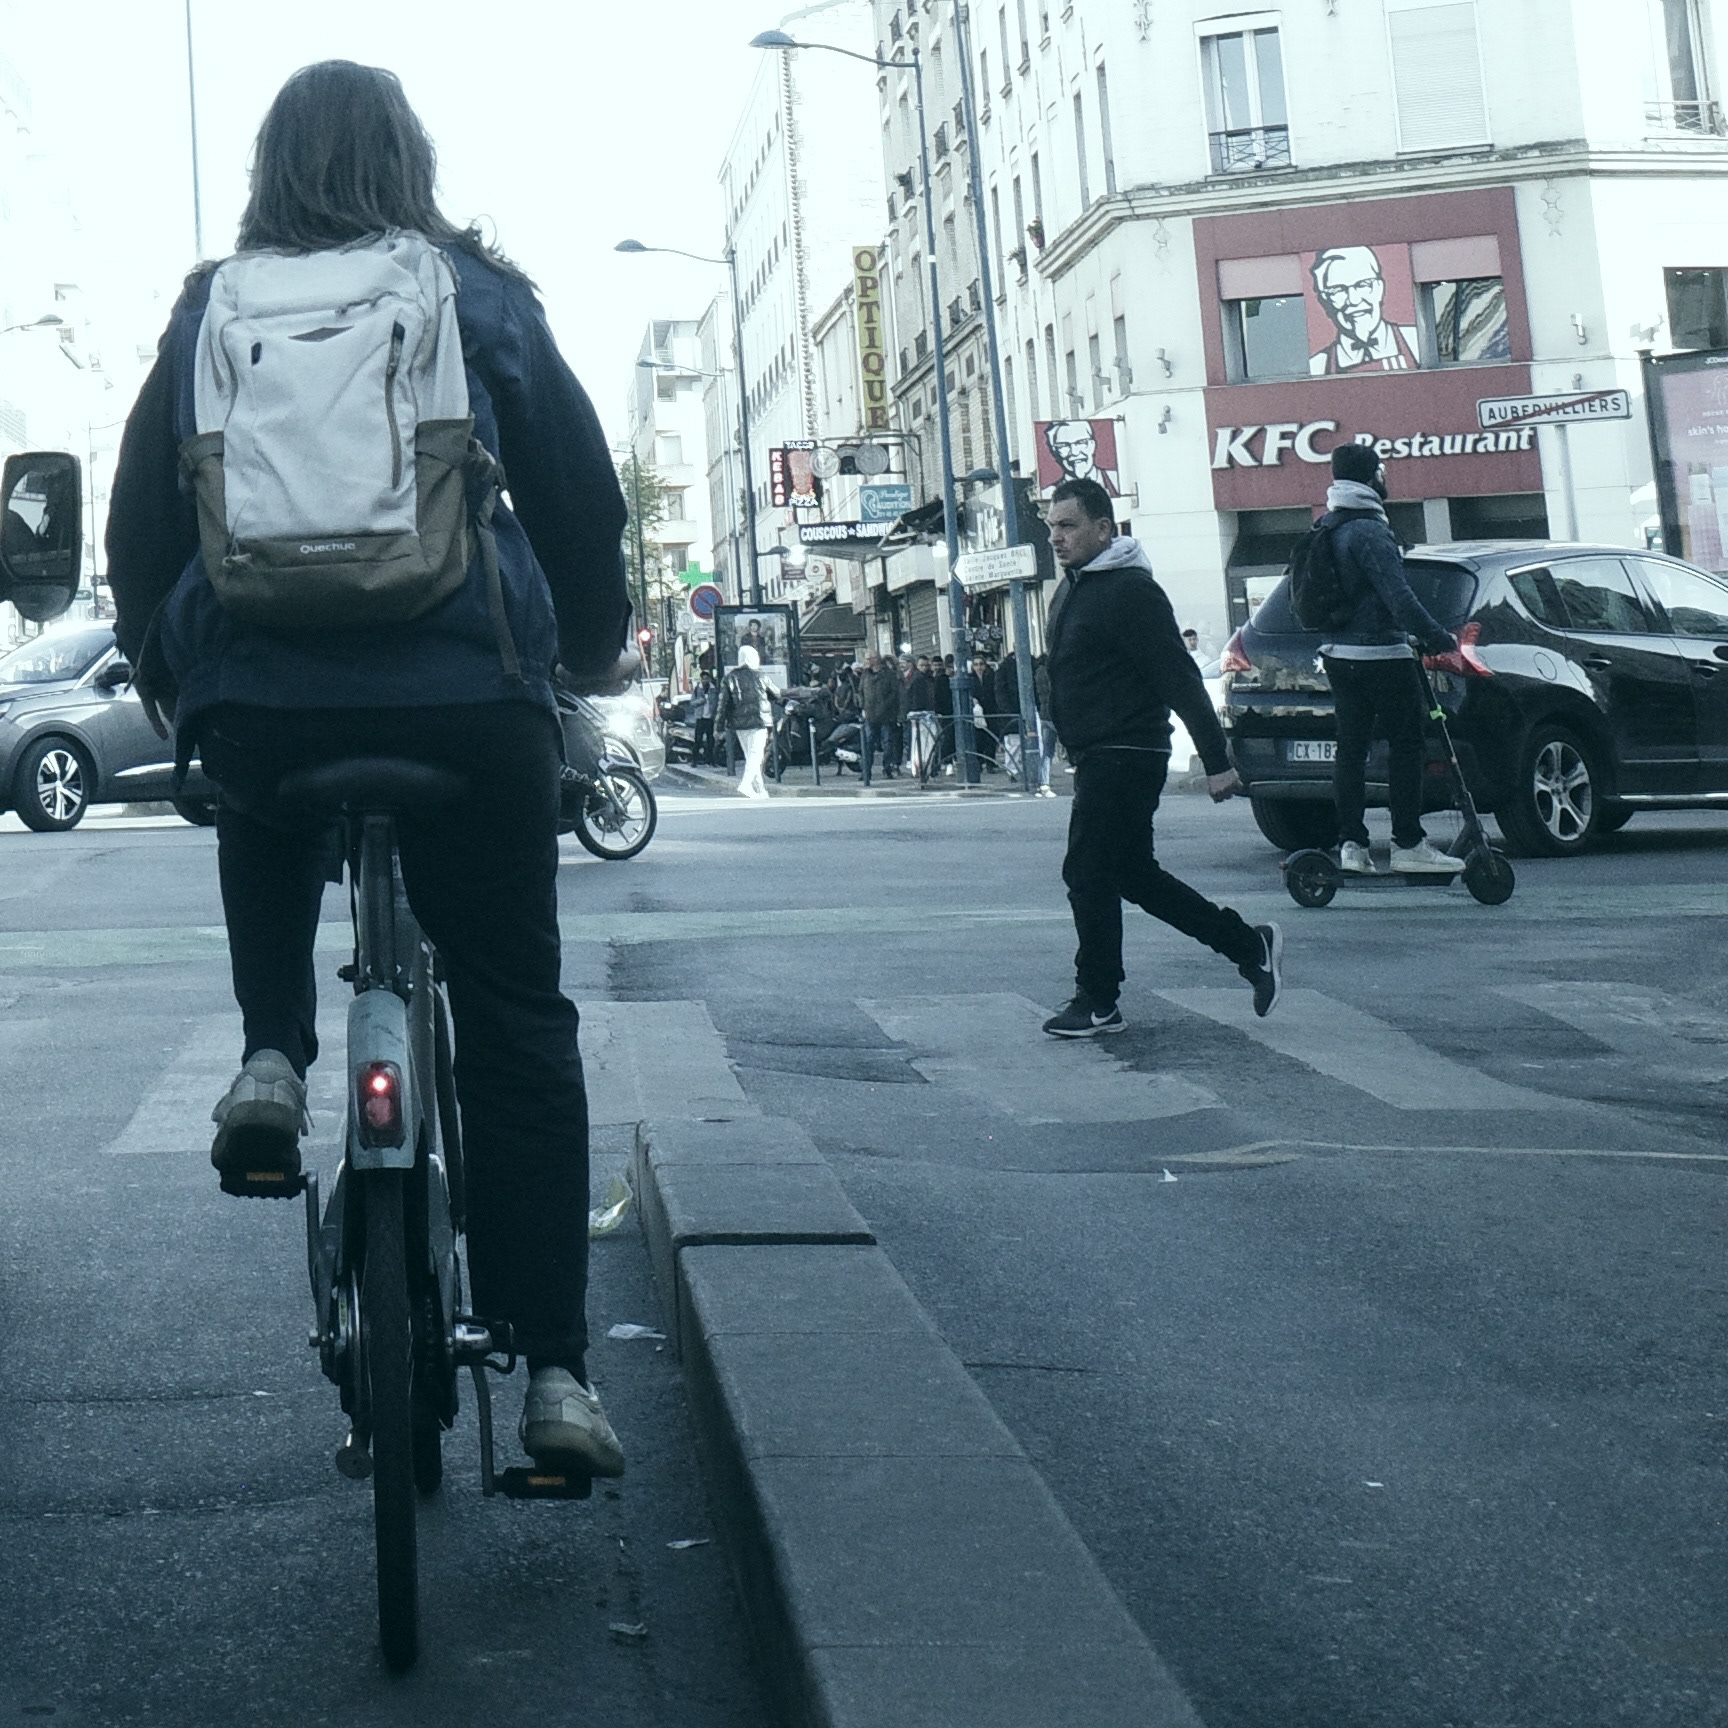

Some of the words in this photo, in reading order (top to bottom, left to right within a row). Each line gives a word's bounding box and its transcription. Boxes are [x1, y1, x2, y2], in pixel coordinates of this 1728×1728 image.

[854, 249, 889, 429] OPTIQUE
[1487, 397, 1622, 422] AUBERVILLIERS
[784, 441, 815, 450] TACOS
[1211, 419, 1337, 469] KFC
[771, 450, 786, 506] KEBAB
[788, 497, 819, 507] PIZZA
[800, 524, 848, 542] COUSCOUS
